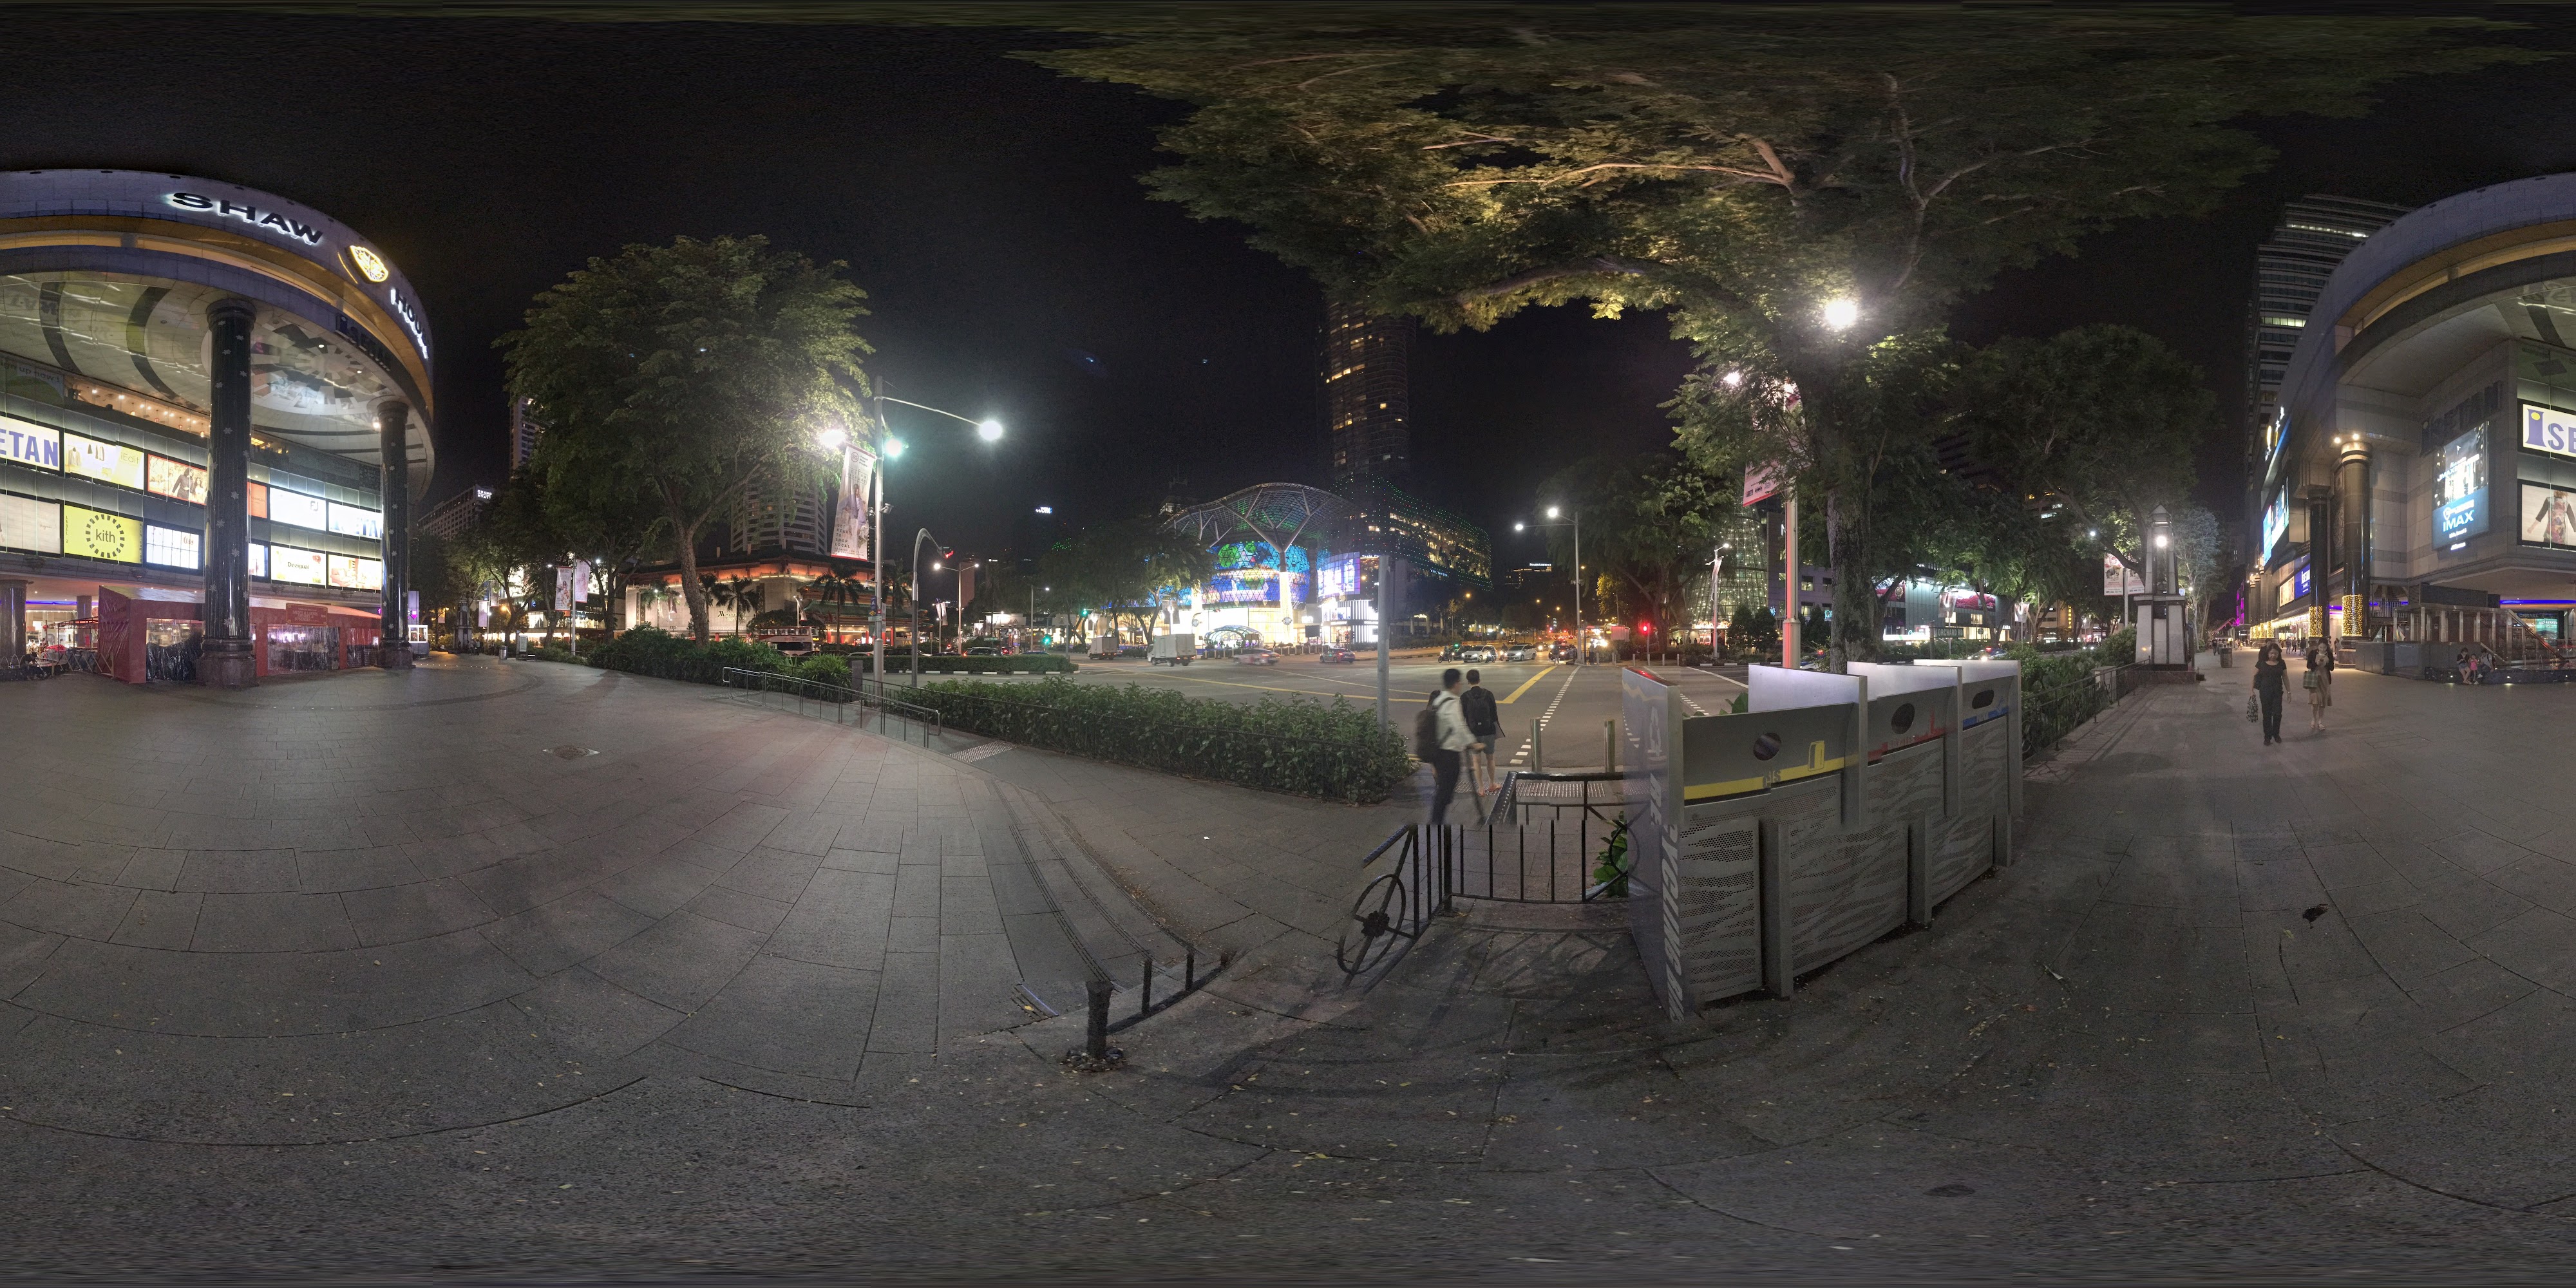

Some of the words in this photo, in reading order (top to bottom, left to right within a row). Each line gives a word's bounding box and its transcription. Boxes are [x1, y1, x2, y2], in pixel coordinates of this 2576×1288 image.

[171, 192, 323, 244] SHAW
[390, 288, 429, 359] HOU
[121, 452, 138, 464] iEdit
[95, 528, 115, 544] kith
[2443, 511, 2474, 532] IMAX
[1649, 772, 1681, 976] RECYCLING
[1665, 965, 1684, 1023] BIN
